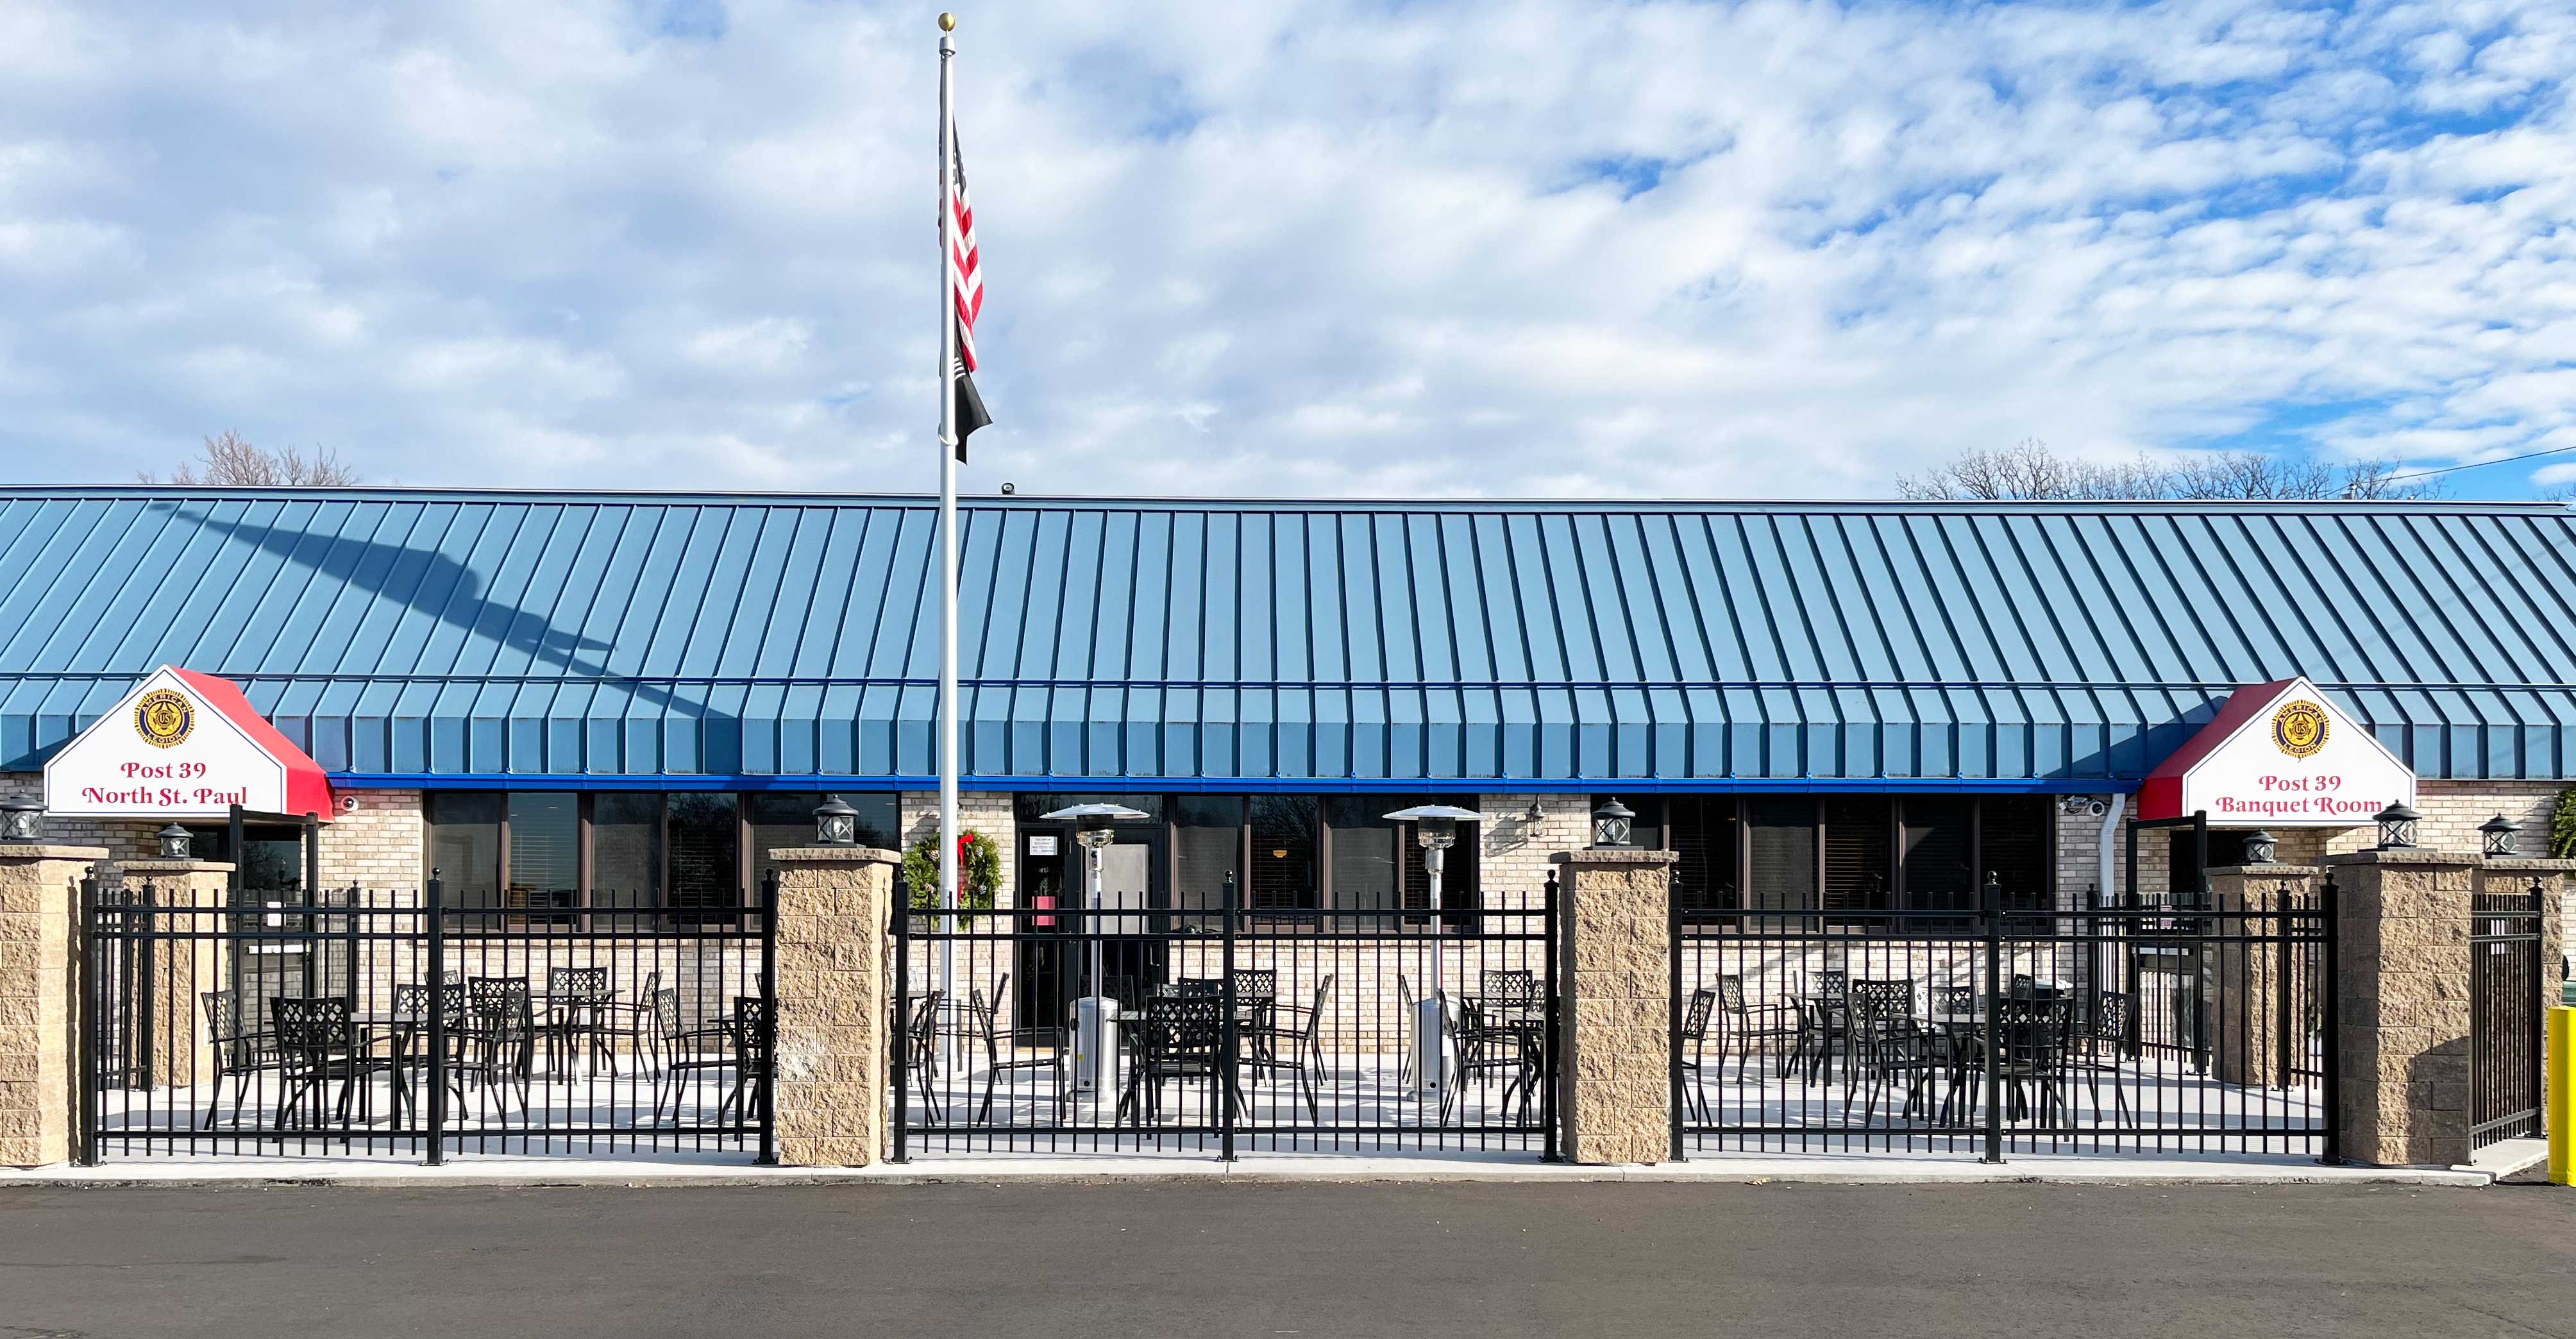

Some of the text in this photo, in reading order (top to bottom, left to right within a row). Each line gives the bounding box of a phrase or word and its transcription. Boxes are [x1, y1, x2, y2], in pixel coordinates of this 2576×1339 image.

[141, 694, 189, 713] AMERICAN
[159, 714, 171, 723] US
[2278, 705, 2324, 723] AMERICAN
[2295, 725, 2306, 733] US
[147, 733, 181, 743] LEGION
[2283, 742, 2317, 753] LEGION
[121, 762, 206, 779] Post 39
[2259, 775, 2341, 791] Post 39
[82, 786, 247, 807] North St. Paul
[2215, 796, 2382, 817] Banquet Room
